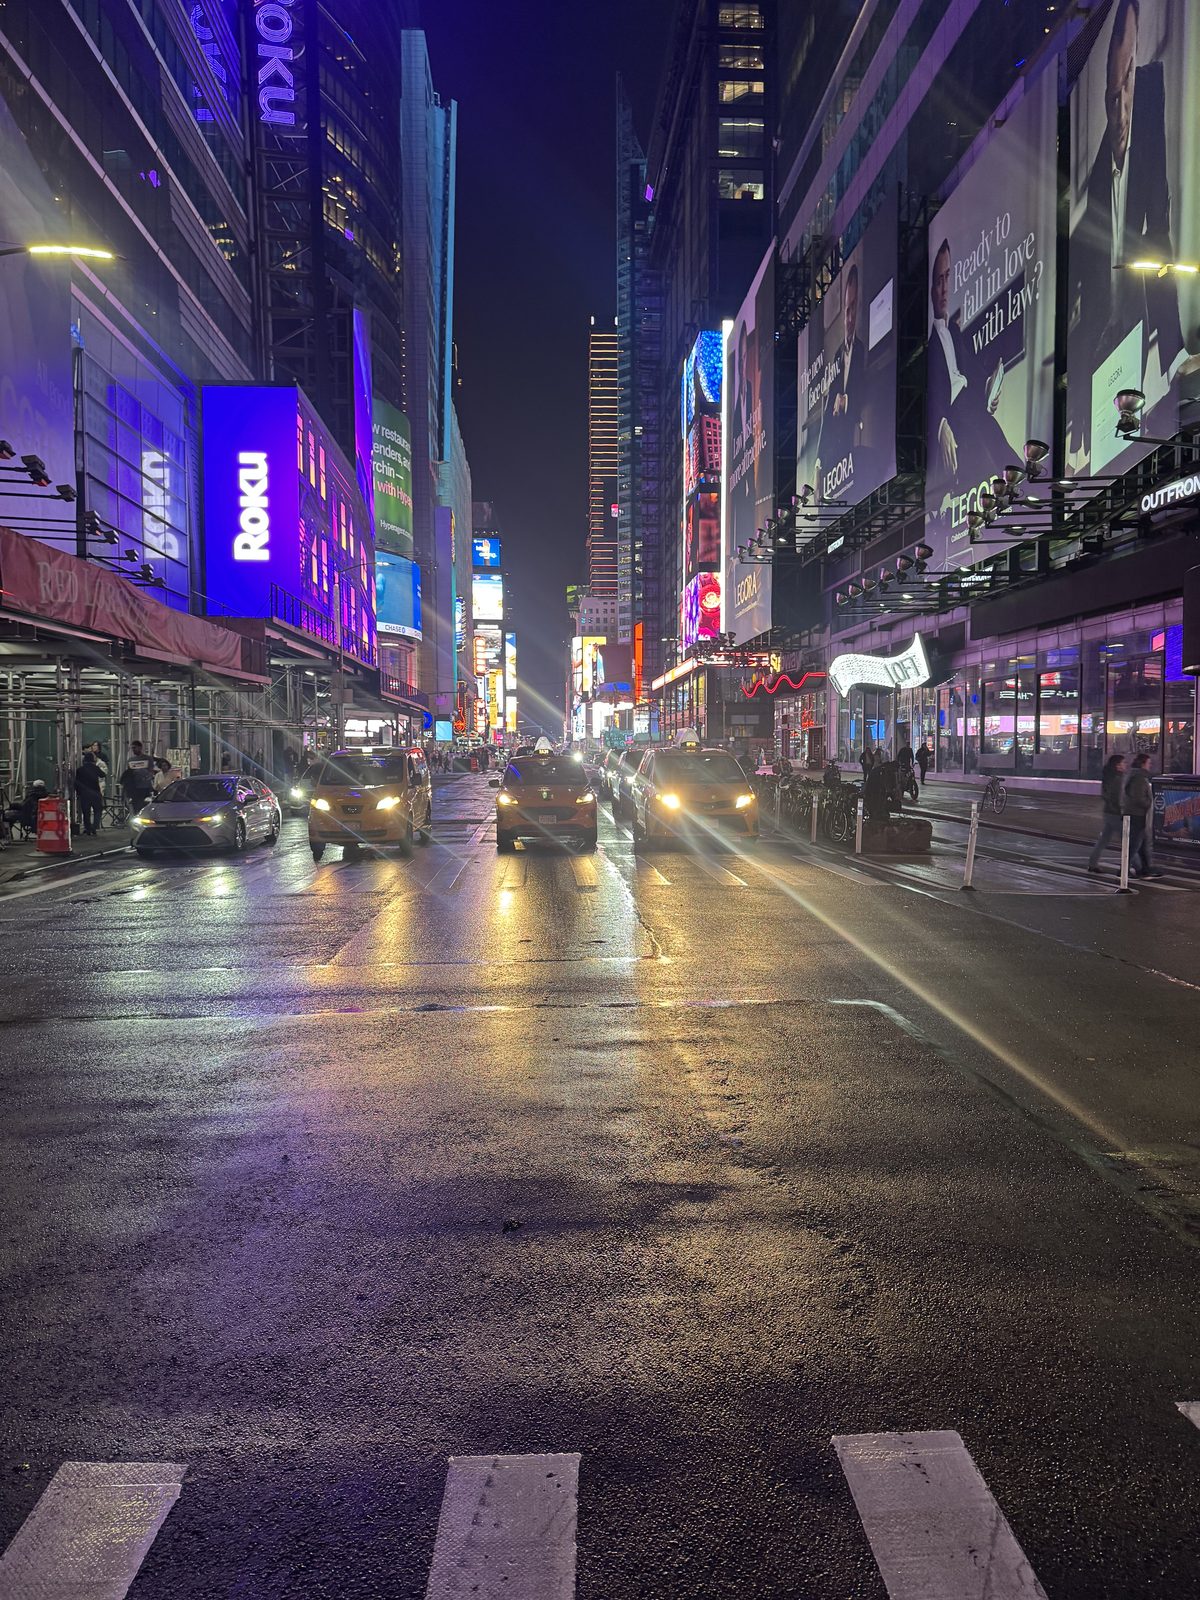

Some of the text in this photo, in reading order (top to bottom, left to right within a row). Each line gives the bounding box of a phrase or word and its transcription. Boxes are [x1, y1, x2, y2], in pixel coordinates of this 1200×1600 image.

[255, 0, 295, 125] OKU
[953, 212, 1011, 294] Ready to
[961, 232, 1035, 326] fall in love
[972, 260, 1044, 355] with law?
[233, 452, 270, 560] ROKU
[377, 480, 397, 499] with
[823, 452, 854, 499] LEGORA
[384, 624, 402, 634] CHASE
[734, 571, 758, 609] LEGORA
